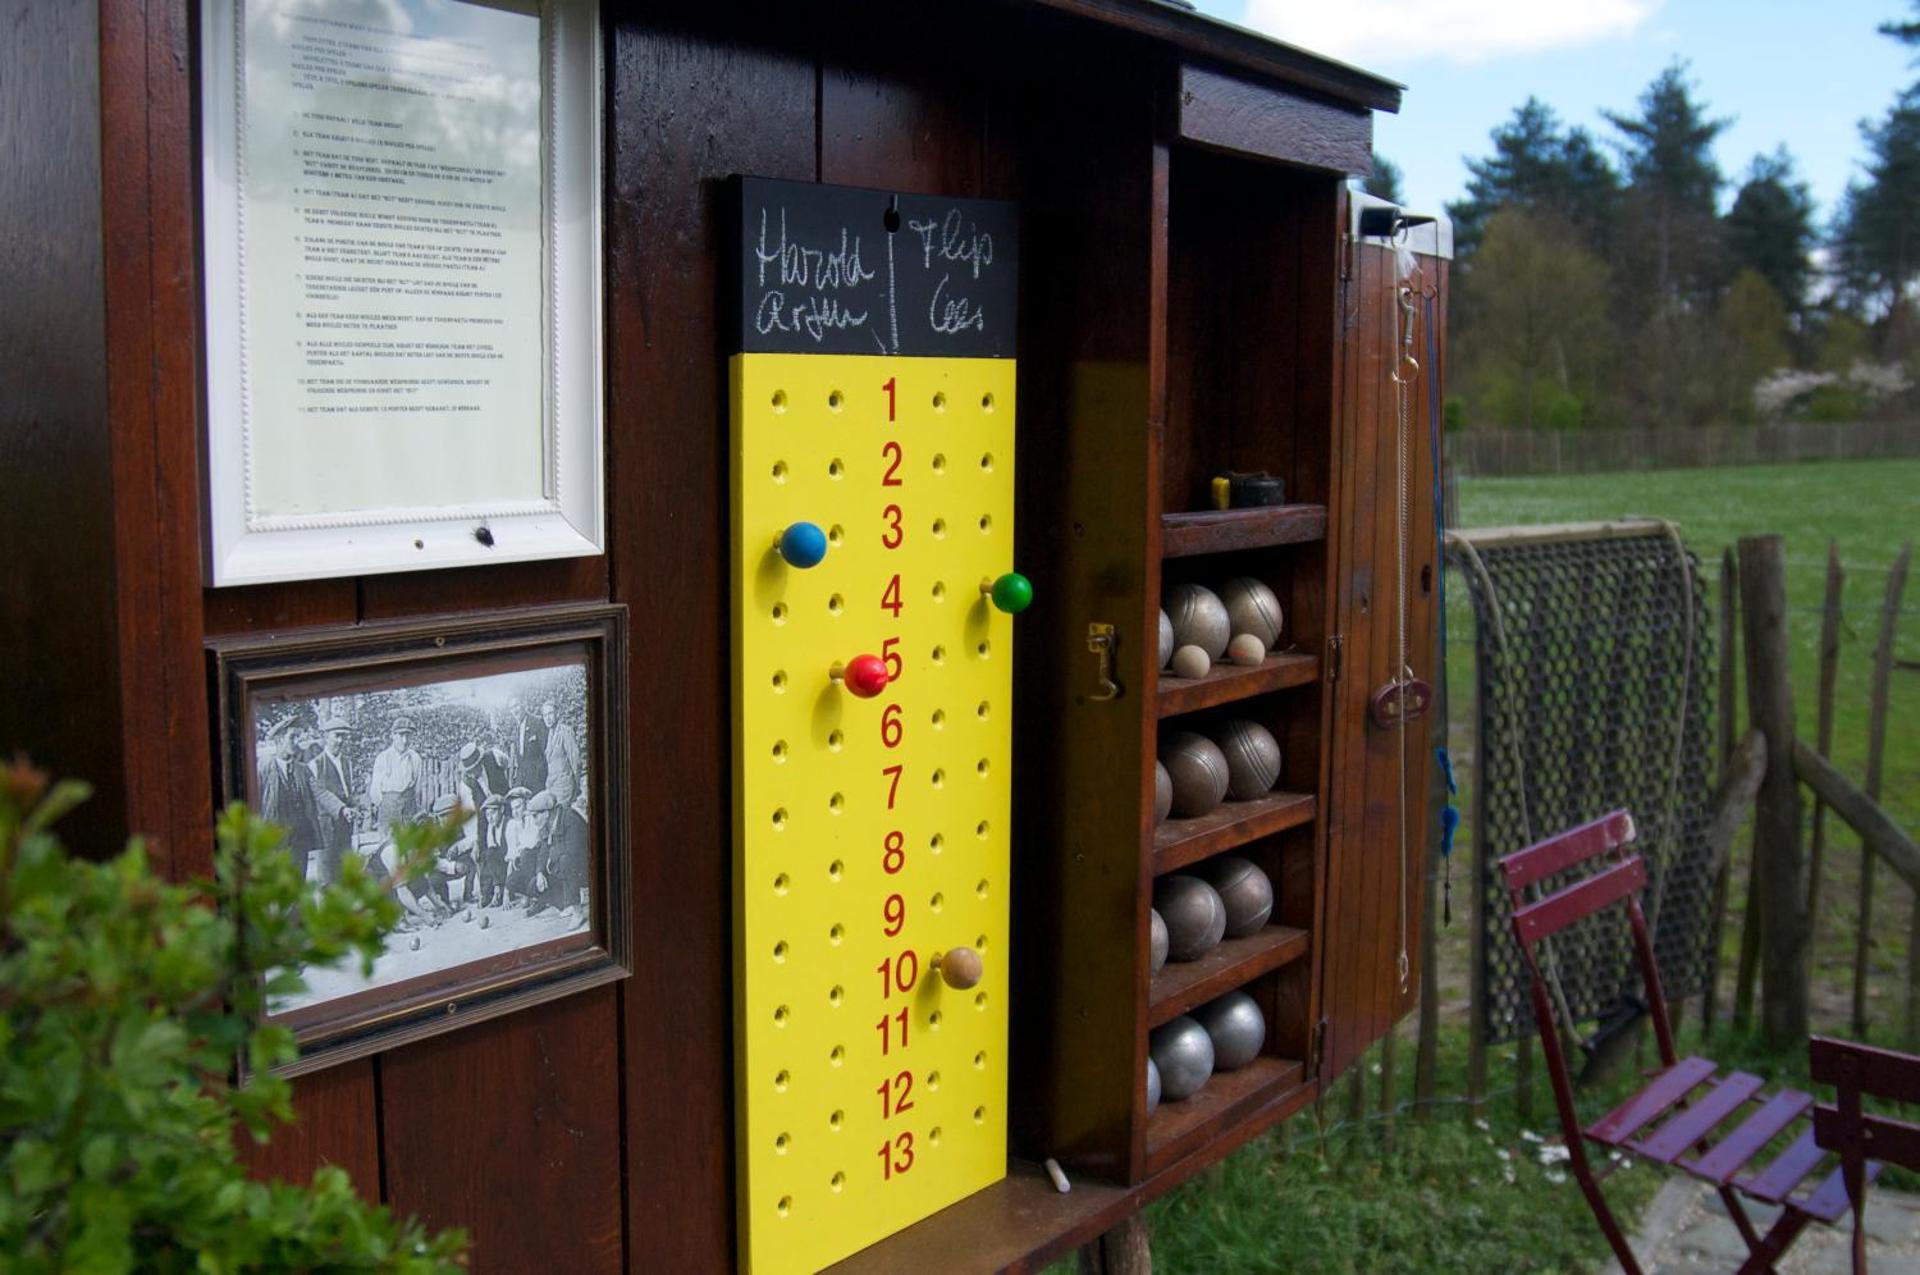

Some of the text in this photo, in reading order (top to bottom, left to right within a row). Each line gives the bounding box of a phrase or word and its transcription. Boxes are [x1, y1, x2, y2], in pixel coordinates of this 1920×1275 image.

[755, 206, 875, 291] Harold
[882, 376, 897, 422] 1
[881, 440, 903, 487] 2
[881, 503, 904, 550] 3
[880, 574, 904, 618] 4
[882, 636, 903, 682] 5
[880, 703, 904, 749] 6
[882, 765, 904, 810] 7
[881, 830, 906, 875] 8
[883, 893, 906, 938] 9
[878, 950, 918, 999] 10
[876, 1006, 910, 1056] 11
[877, 1069, 915, 1120] 12
[878, 1130, 915, 1180] 13
